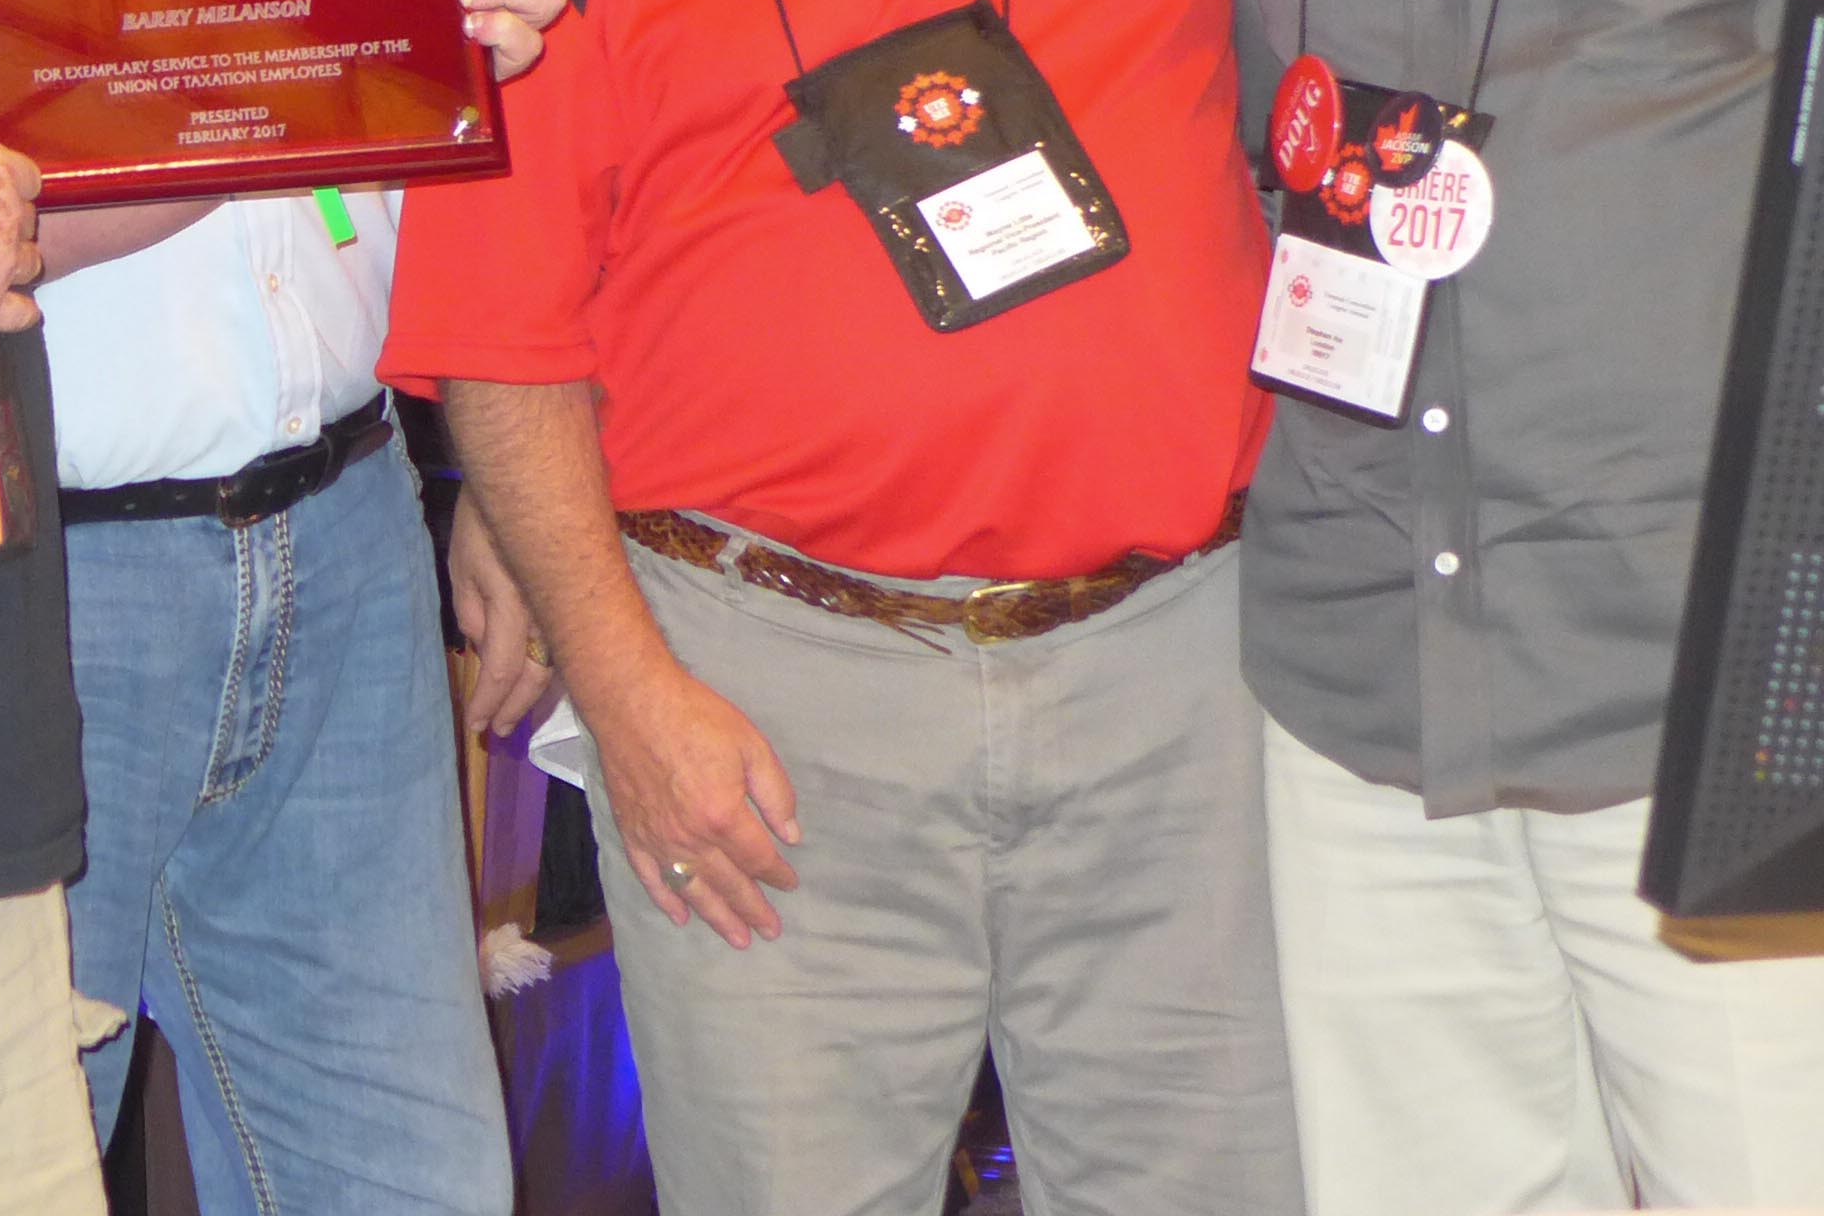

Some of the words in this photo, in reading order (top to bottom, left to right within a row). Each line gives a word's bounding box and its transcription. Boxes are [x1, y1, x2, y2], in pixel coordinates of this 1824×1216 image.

[121, 6, 193, 31] BARRY
[33, 68, 62, 83] FOR
[64, 59, 150, 80] EXEMPLARY
[152, 55, 208, 73] SERVICE
[210, 53, 231, 68] TO
[233, 51, 262, 66] THE
[264, 43, 359, 64] MEMBERSHIP
[360, 41, 381, 56] OF
[382, 39, 411, 54] THE
[107, 79, 158, 95] UNION
[161, 76, 181, 91] OF
[183, 71, 258, 89] TAXATION
[260, 64, 343, 84] EMPLOYEES
[190, 106, 270, 125] PRESENTED
[178, 127, 250, 145] FEBRUARY
[252, 124, 287, 140] 2017
[1387, 203, 1466, 251] 2017
